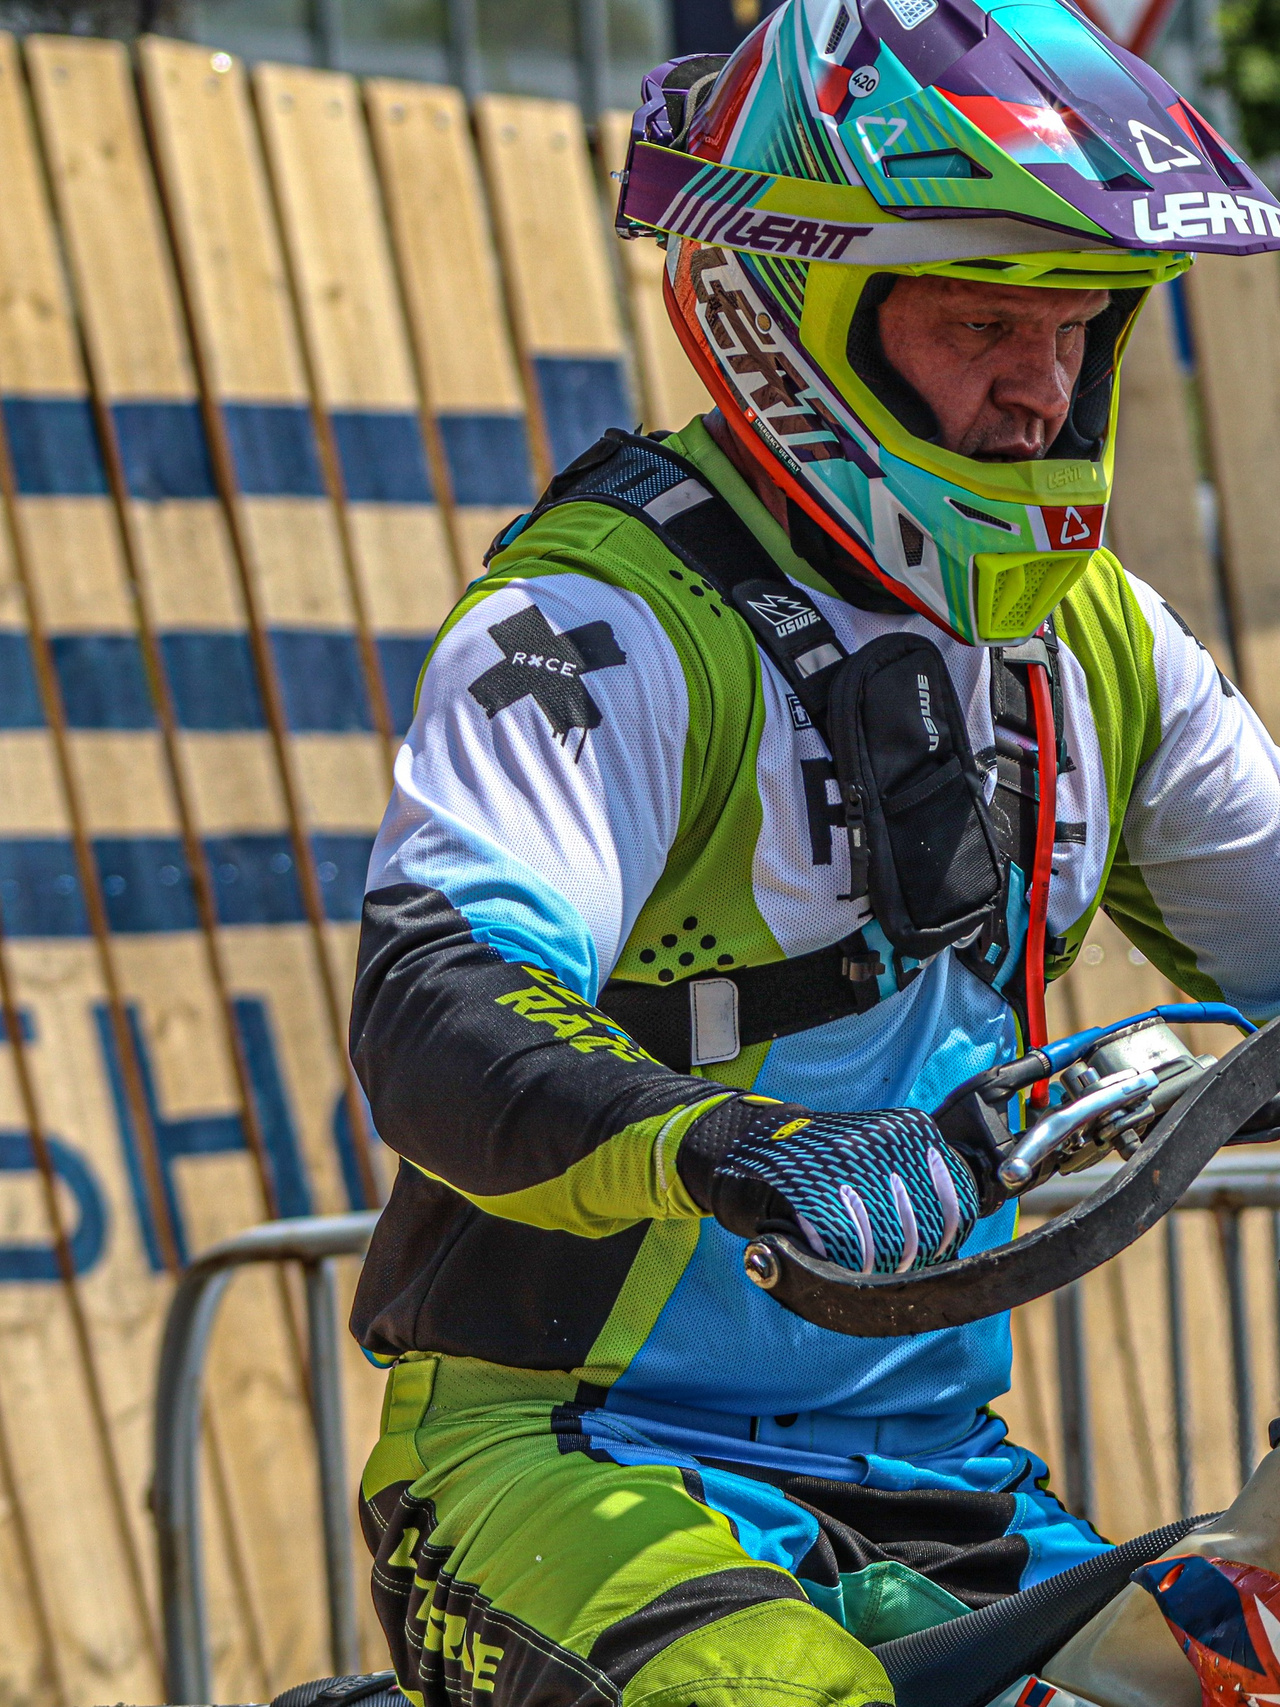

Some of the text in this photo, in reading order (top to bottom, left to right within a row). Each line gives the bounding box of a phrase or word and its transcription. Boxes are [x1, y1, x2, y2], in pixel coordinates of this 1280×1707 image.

[851, 72, 877, 92] 420
[723, 211, 874, 260] LEATT
[690, 245, 887, 479] LEATT
[754, 418, 800, 472] EMERGENCY USE ONLY
[1046, 465, 1082, 490] LEATT
[917, 673, 940, 752] USWE
